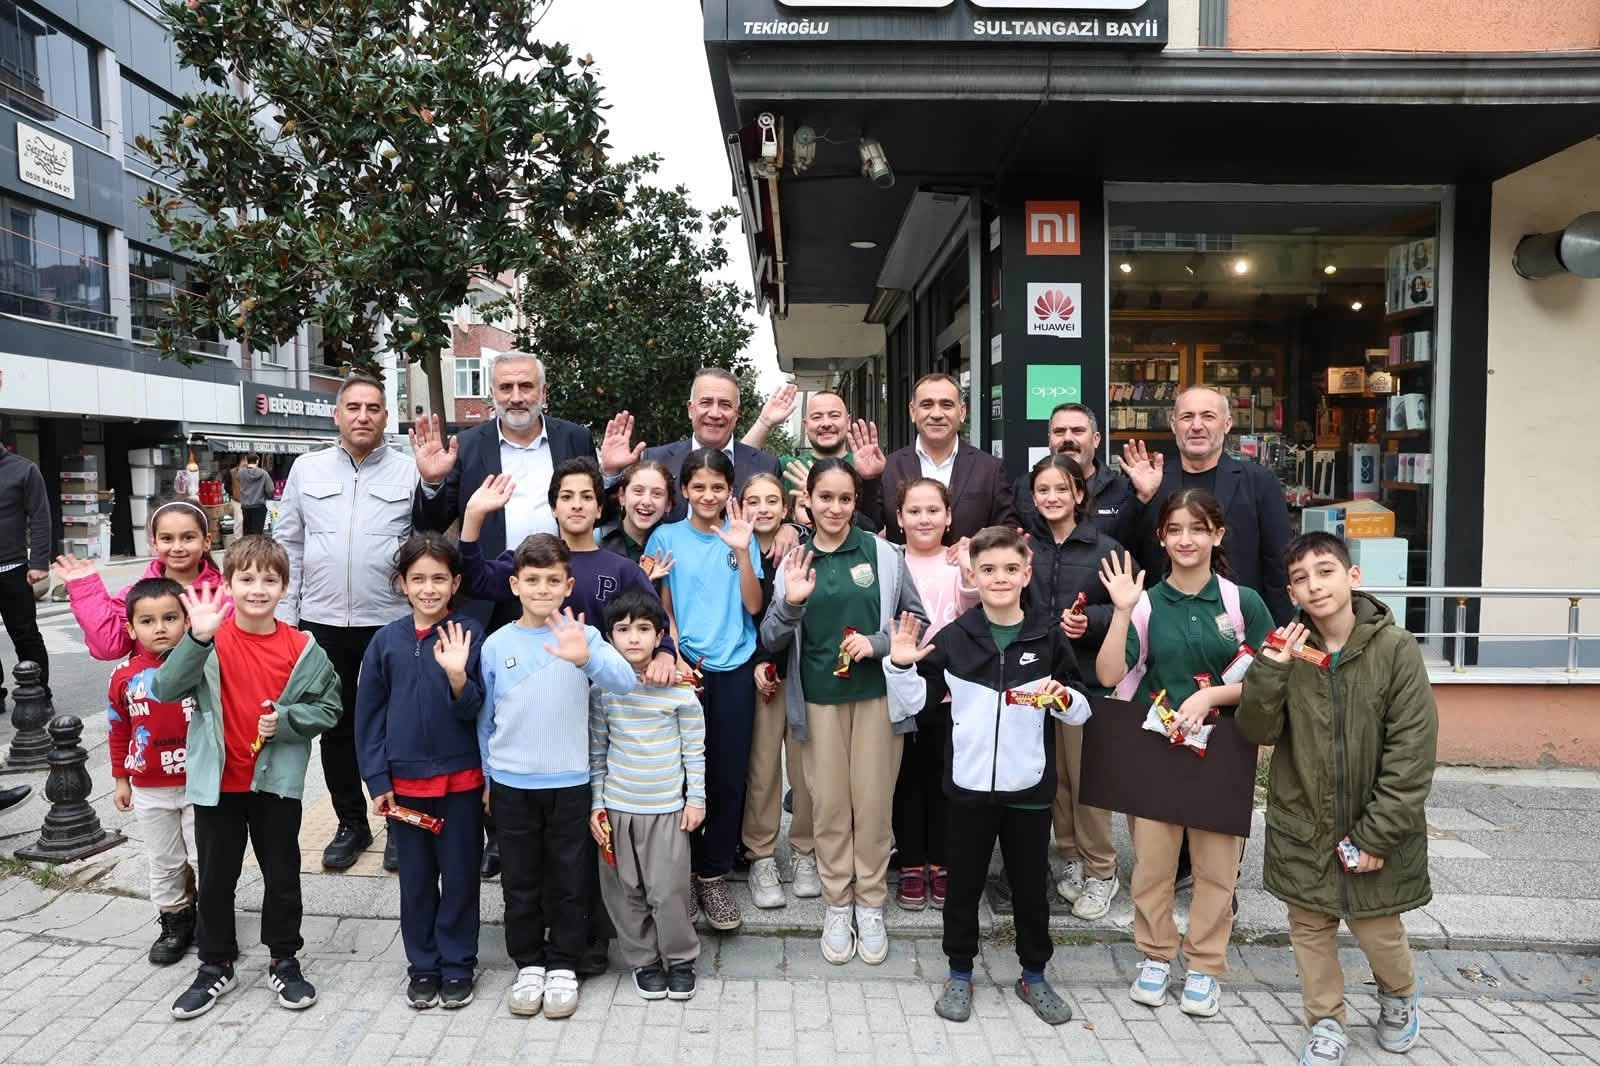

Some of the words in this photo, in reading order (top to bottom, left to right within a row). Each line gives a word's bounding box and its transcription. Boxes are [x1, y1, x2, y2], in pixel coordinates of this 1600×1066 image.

[743, 18, 829, 35] TEKİROĞLU
[973, 18, 1099, 36] SULTANGAZİ
[1033, 322, 1075, 332] HUAWEI
[596, 574, 618, 601] P
